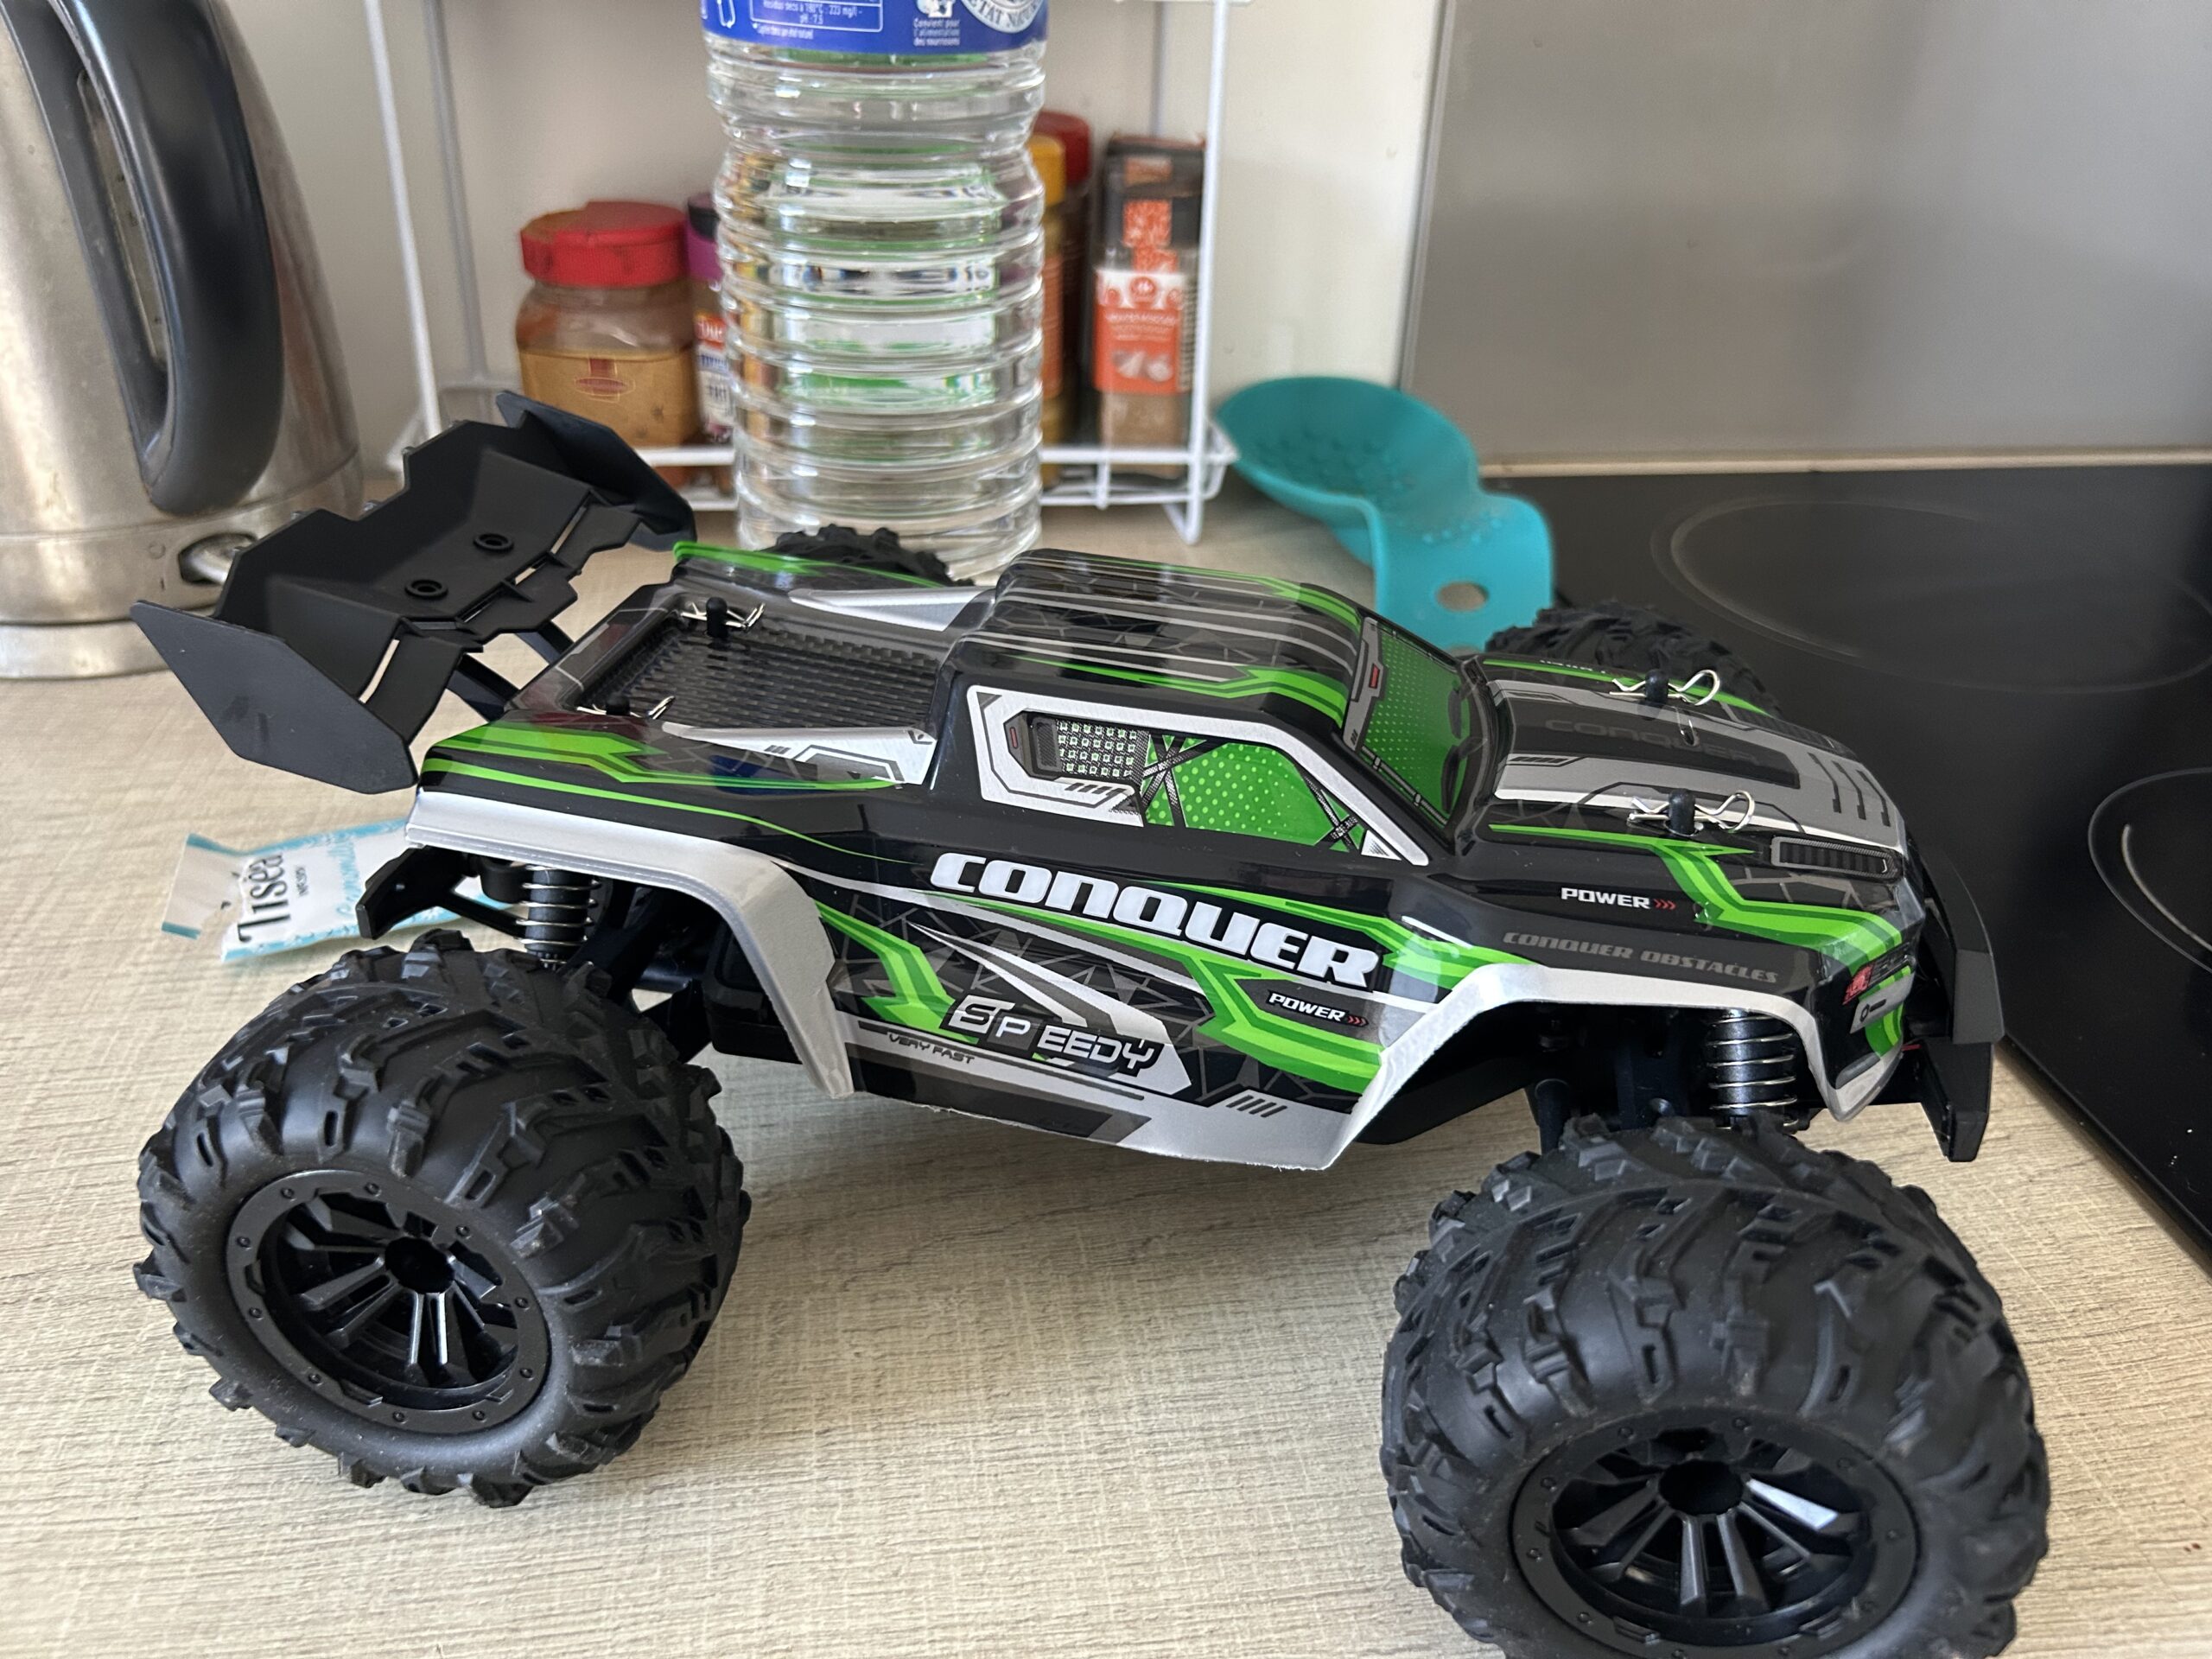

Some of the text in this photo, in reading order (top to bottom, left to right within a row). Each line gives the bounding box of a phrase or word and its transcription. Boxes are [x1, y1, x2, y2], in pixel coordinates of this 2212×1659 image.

[1560, 887, 1652, 909] POWER
[929, 852, 1381, 988] CONQUER
[1502, 931, 1779, 984] CONQUER OBSTACLES
[1267, 992, 1346, 1023] POWER
[887, 1032, 976, 1065] VERY FAST
